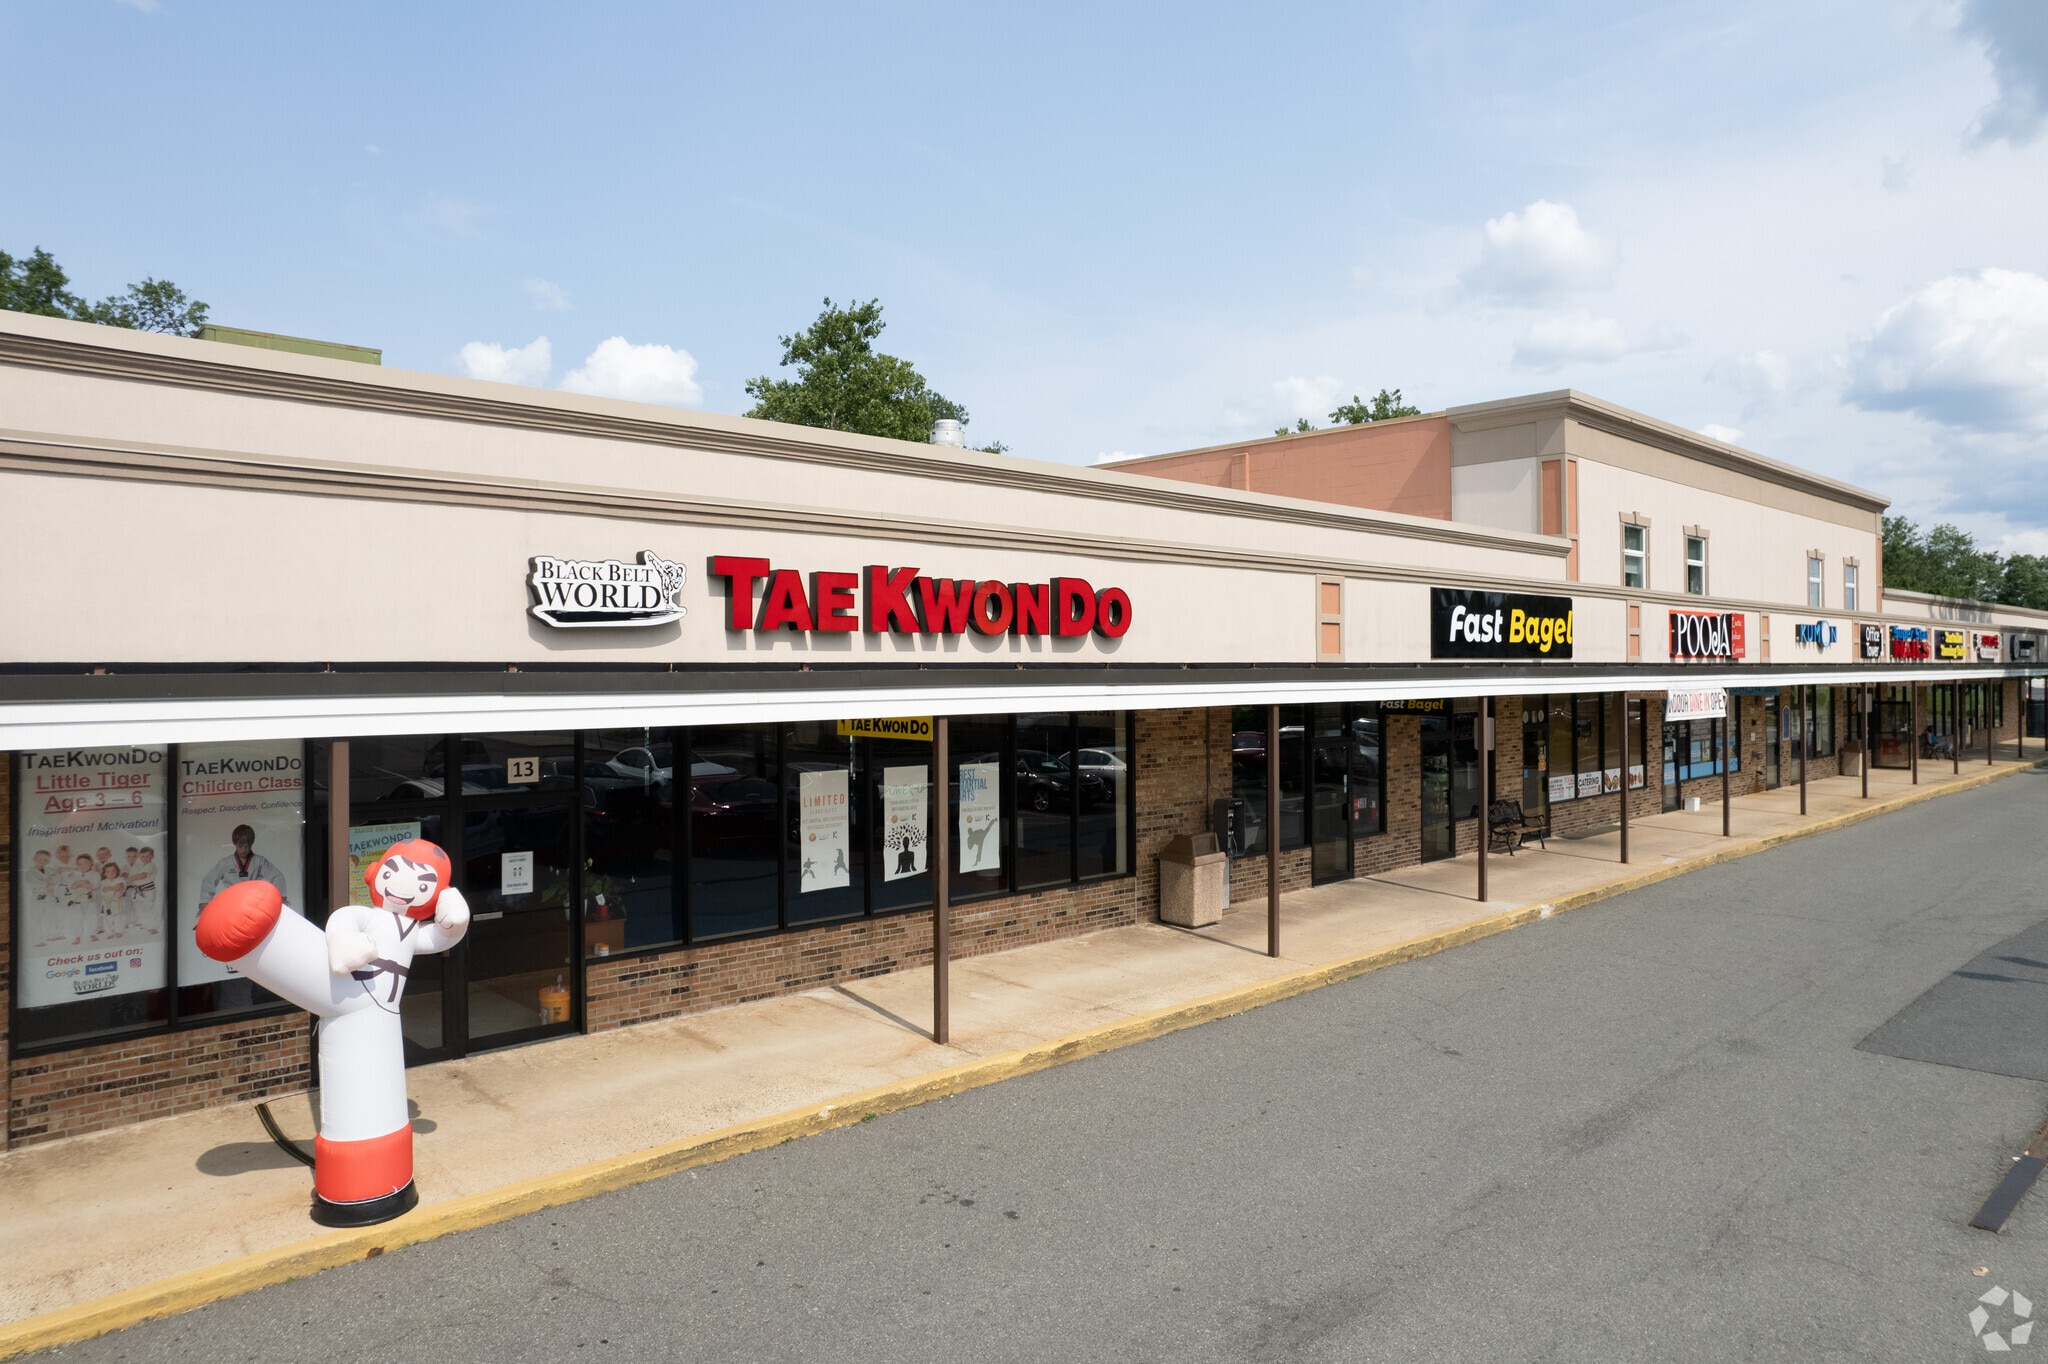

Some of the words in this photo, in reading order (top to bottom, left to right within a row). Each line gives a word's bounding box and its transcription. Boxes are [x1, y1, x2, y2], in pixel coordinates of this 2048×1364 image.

[540, 560, 604, 581] BLACK
[608, 564, 654, 583] BELT
[540, 581, 662, 609] WORLD
[1449, 605, 1503, 643] Fast
[1509, 608, 1573, 653] Bagel
[1677, 613, 1731, 656] POOJA
[1799, 620, 1837, 648] KUMON
[1866, 626, 1880, 642] Office
[1893, 640, 1930, 659] NAILS
[1379, 700, 1404, 709] Fast
[1407, 699, 1444, 712] Bagel
[850, 717, 930, 736] TAEKWONDO
[513, 761, 534, 778] 13
[36, 773, 90, 790] Little
[97, 771, 151, 789] Tiger
[182, 778, 253, 795] Children
[258, 775, 302, 789] Class
[1578, 777, 1599, 787] CATERING
[45, 795, 87, 813] Age
[95, 792, 105, 807] 3
[131, 790, 143, 805] 6
[803, 793, 846, 808] LIMITED
[28, 820, 94, 837] Inspiration!
[97, 818, 159, 832] Motivation!
[47, 955, 84, 967] Check
[87, 953, 101, 962] us
[104, 949, 123, 960] out
[46, 967, 81, 979] Google
[74, 980, 112, 992] WORLD
